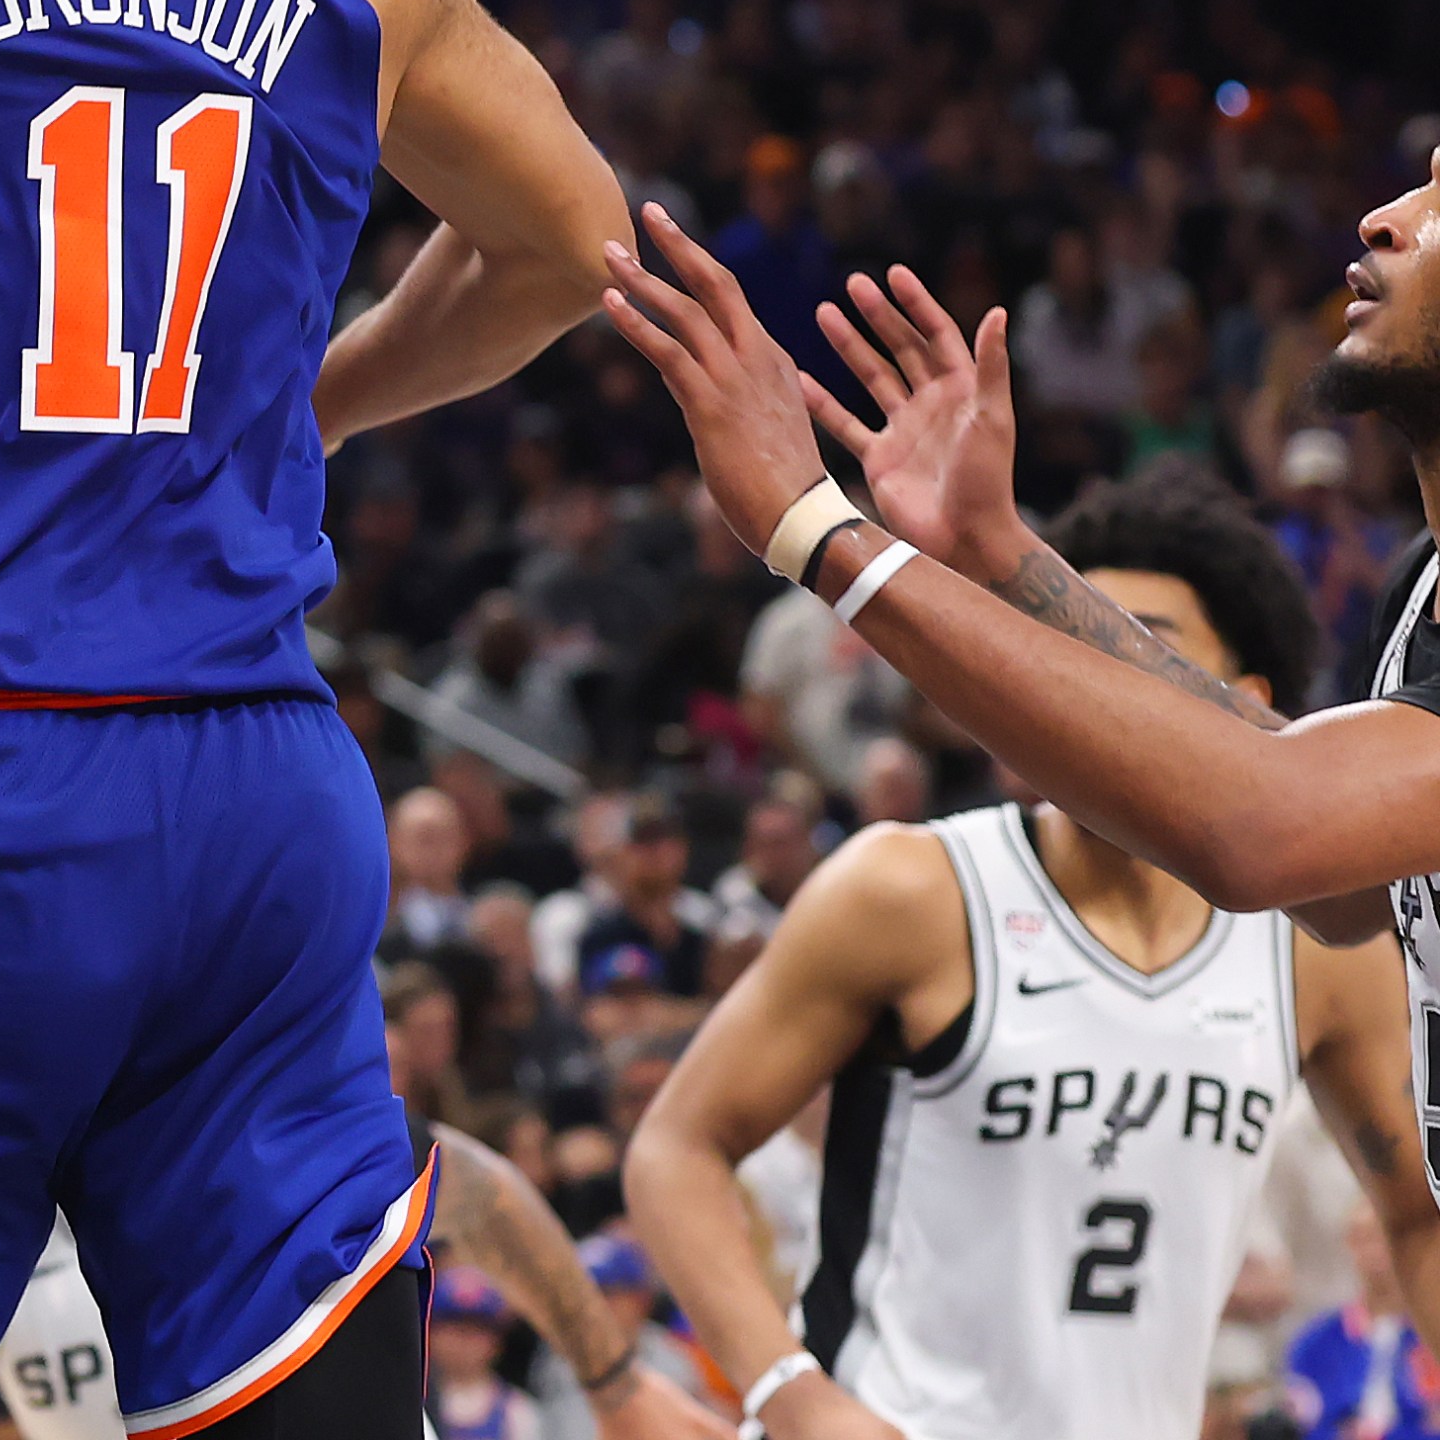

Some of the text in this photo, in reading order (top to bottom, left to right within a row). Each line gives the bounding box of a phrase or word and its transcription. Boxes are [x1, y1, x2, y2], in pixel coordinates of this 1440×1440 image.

[20, 85, 254, 434] 11
[979, 1070, 1273, 1171] SPURS
[1069, 1198, 1154, 1315] 2
